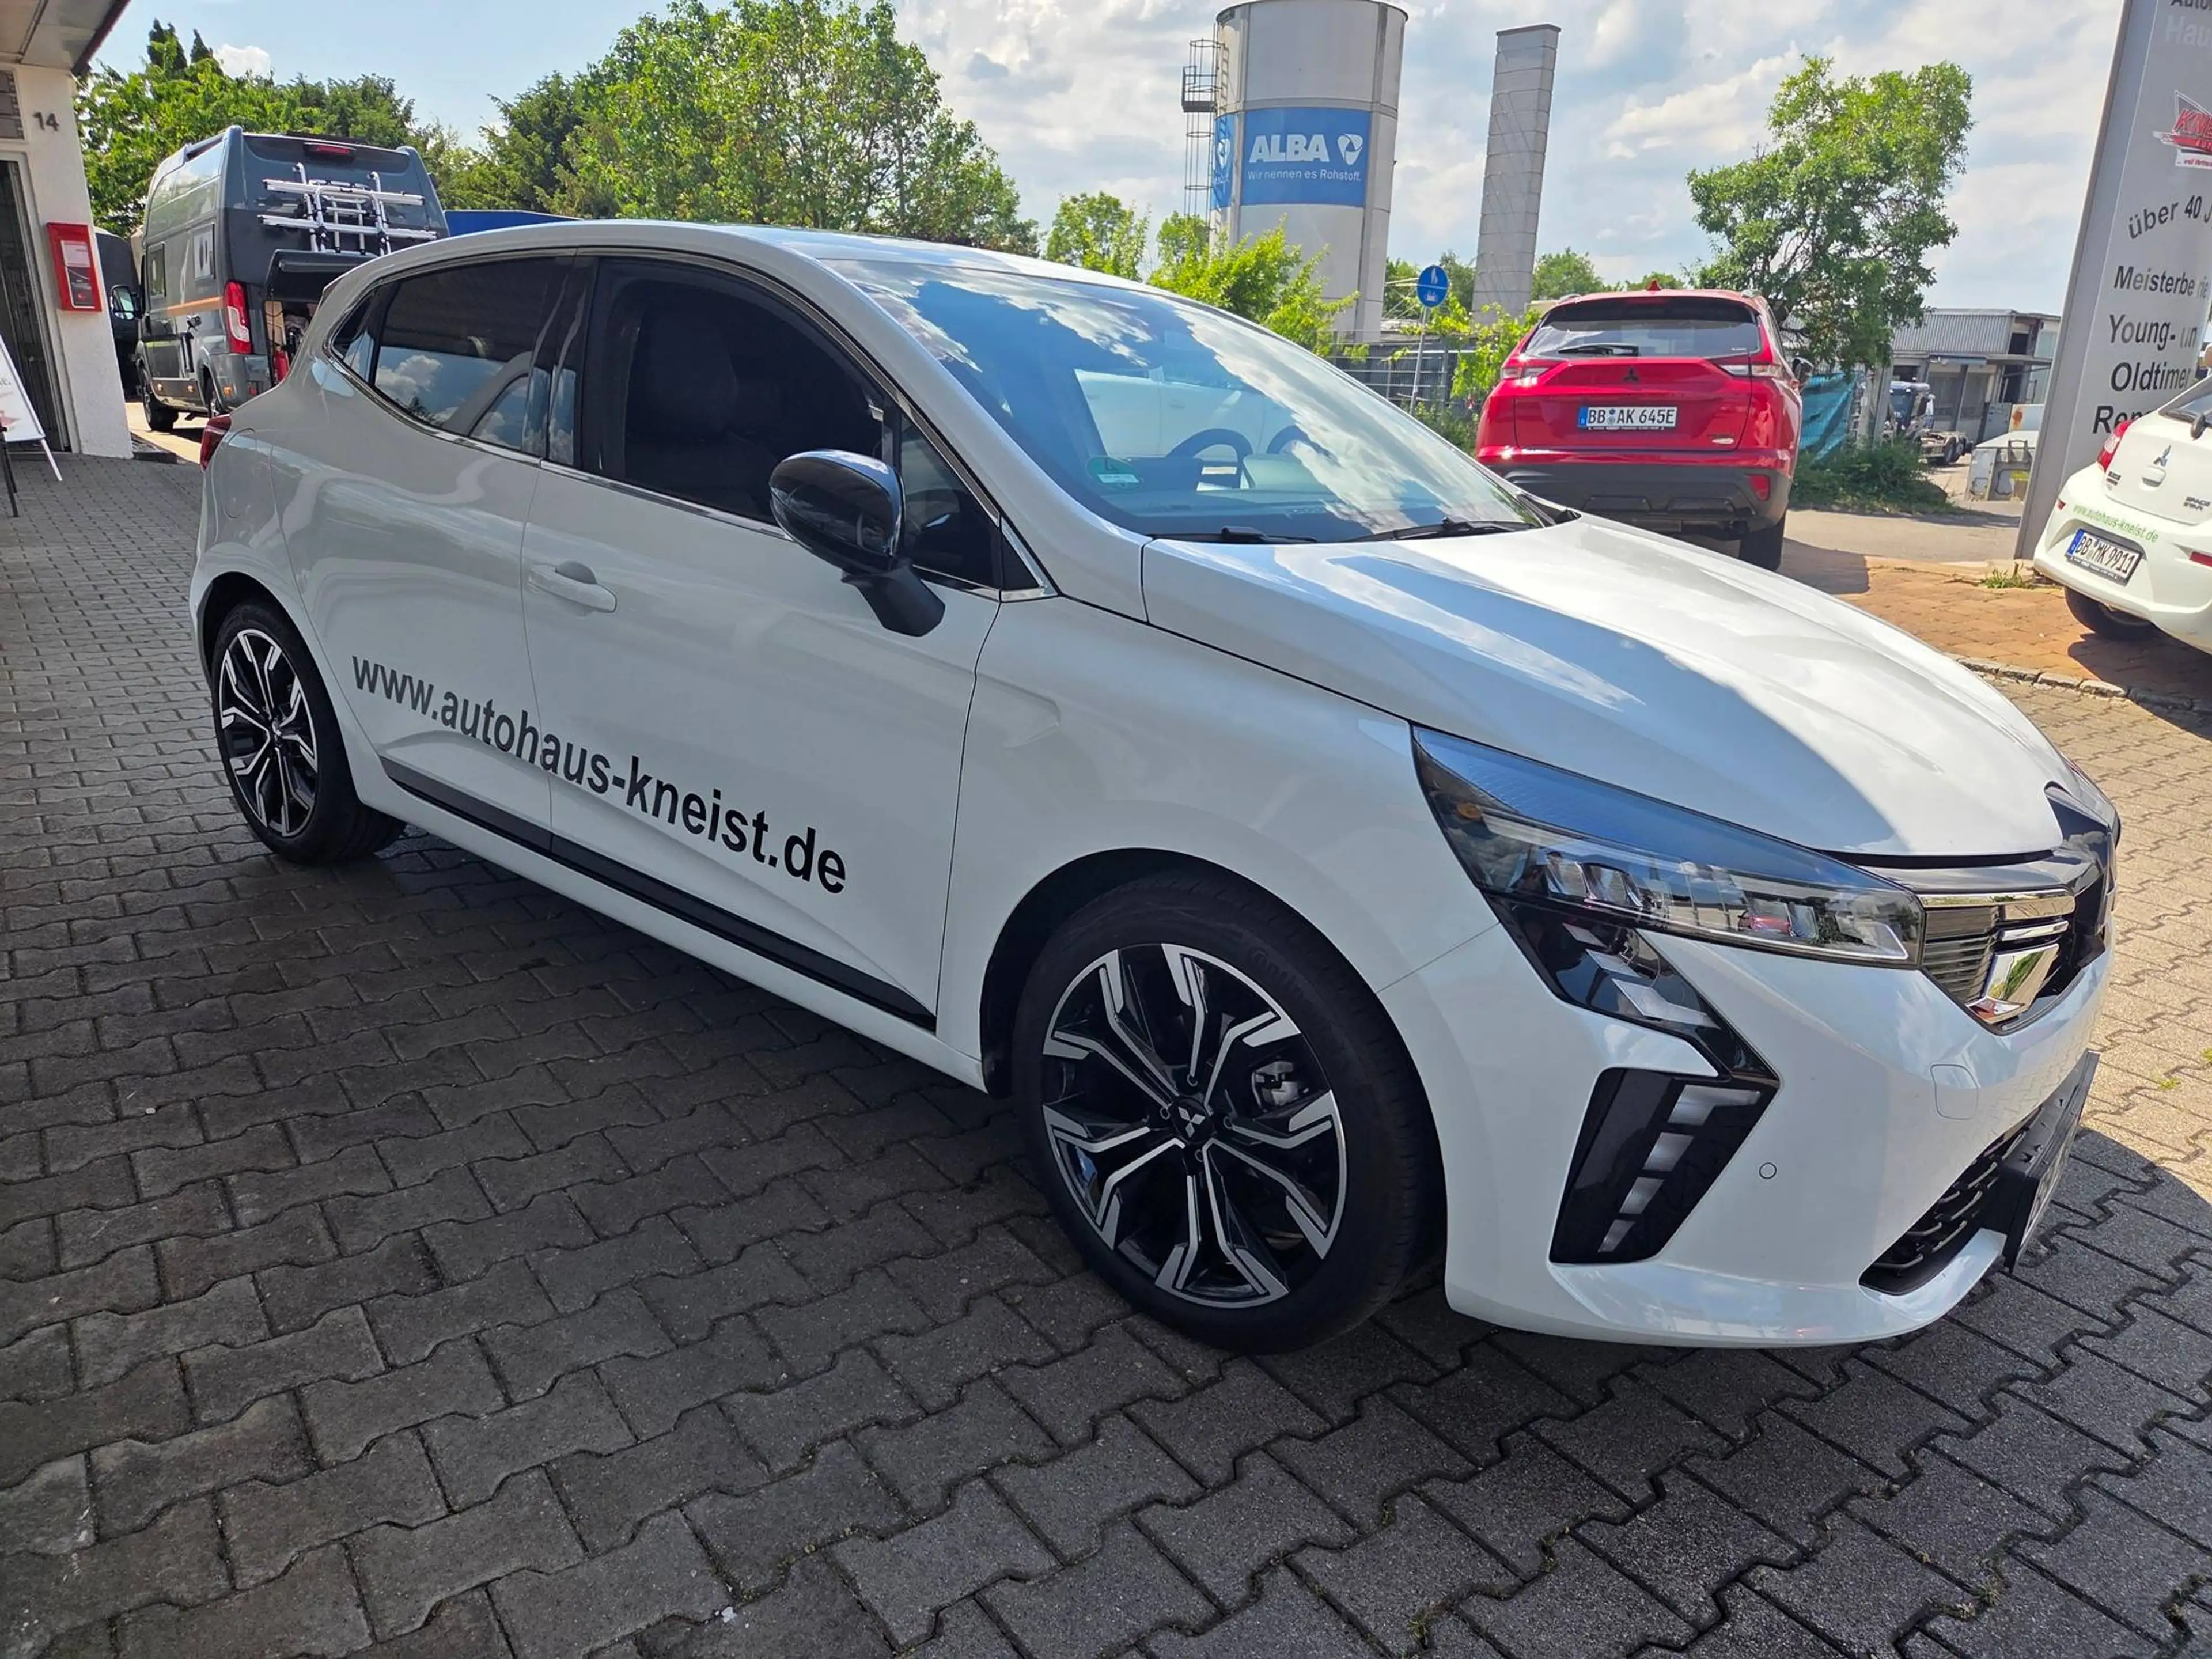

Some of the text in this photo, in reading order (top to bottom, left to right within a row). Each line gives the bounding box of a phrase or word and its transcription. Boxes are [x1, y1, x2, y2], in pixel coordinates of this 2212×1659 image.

[2165, 14, 2212, 47] Hau
[33, 112, 59, 132] 14
[1249, 134, 1330, 163] ALBA
[1247, 170, 1262, 180] Wir
[1264, 170, 1302, 179] nennen
[1304, 170, 1317, 179] es
[2128, 202, 2179, 240] über
[2184, 195, 2202, 219] 40
[2109, 314, 2176, 351] Young-
[1588, 409, 1675, 423] BB AK 645E
[2075, 535, 2092, 555] BB
[2105, 547, 2136, 573] 9911
[353, 656, 846, 893] www.autohaus-kneist.de
